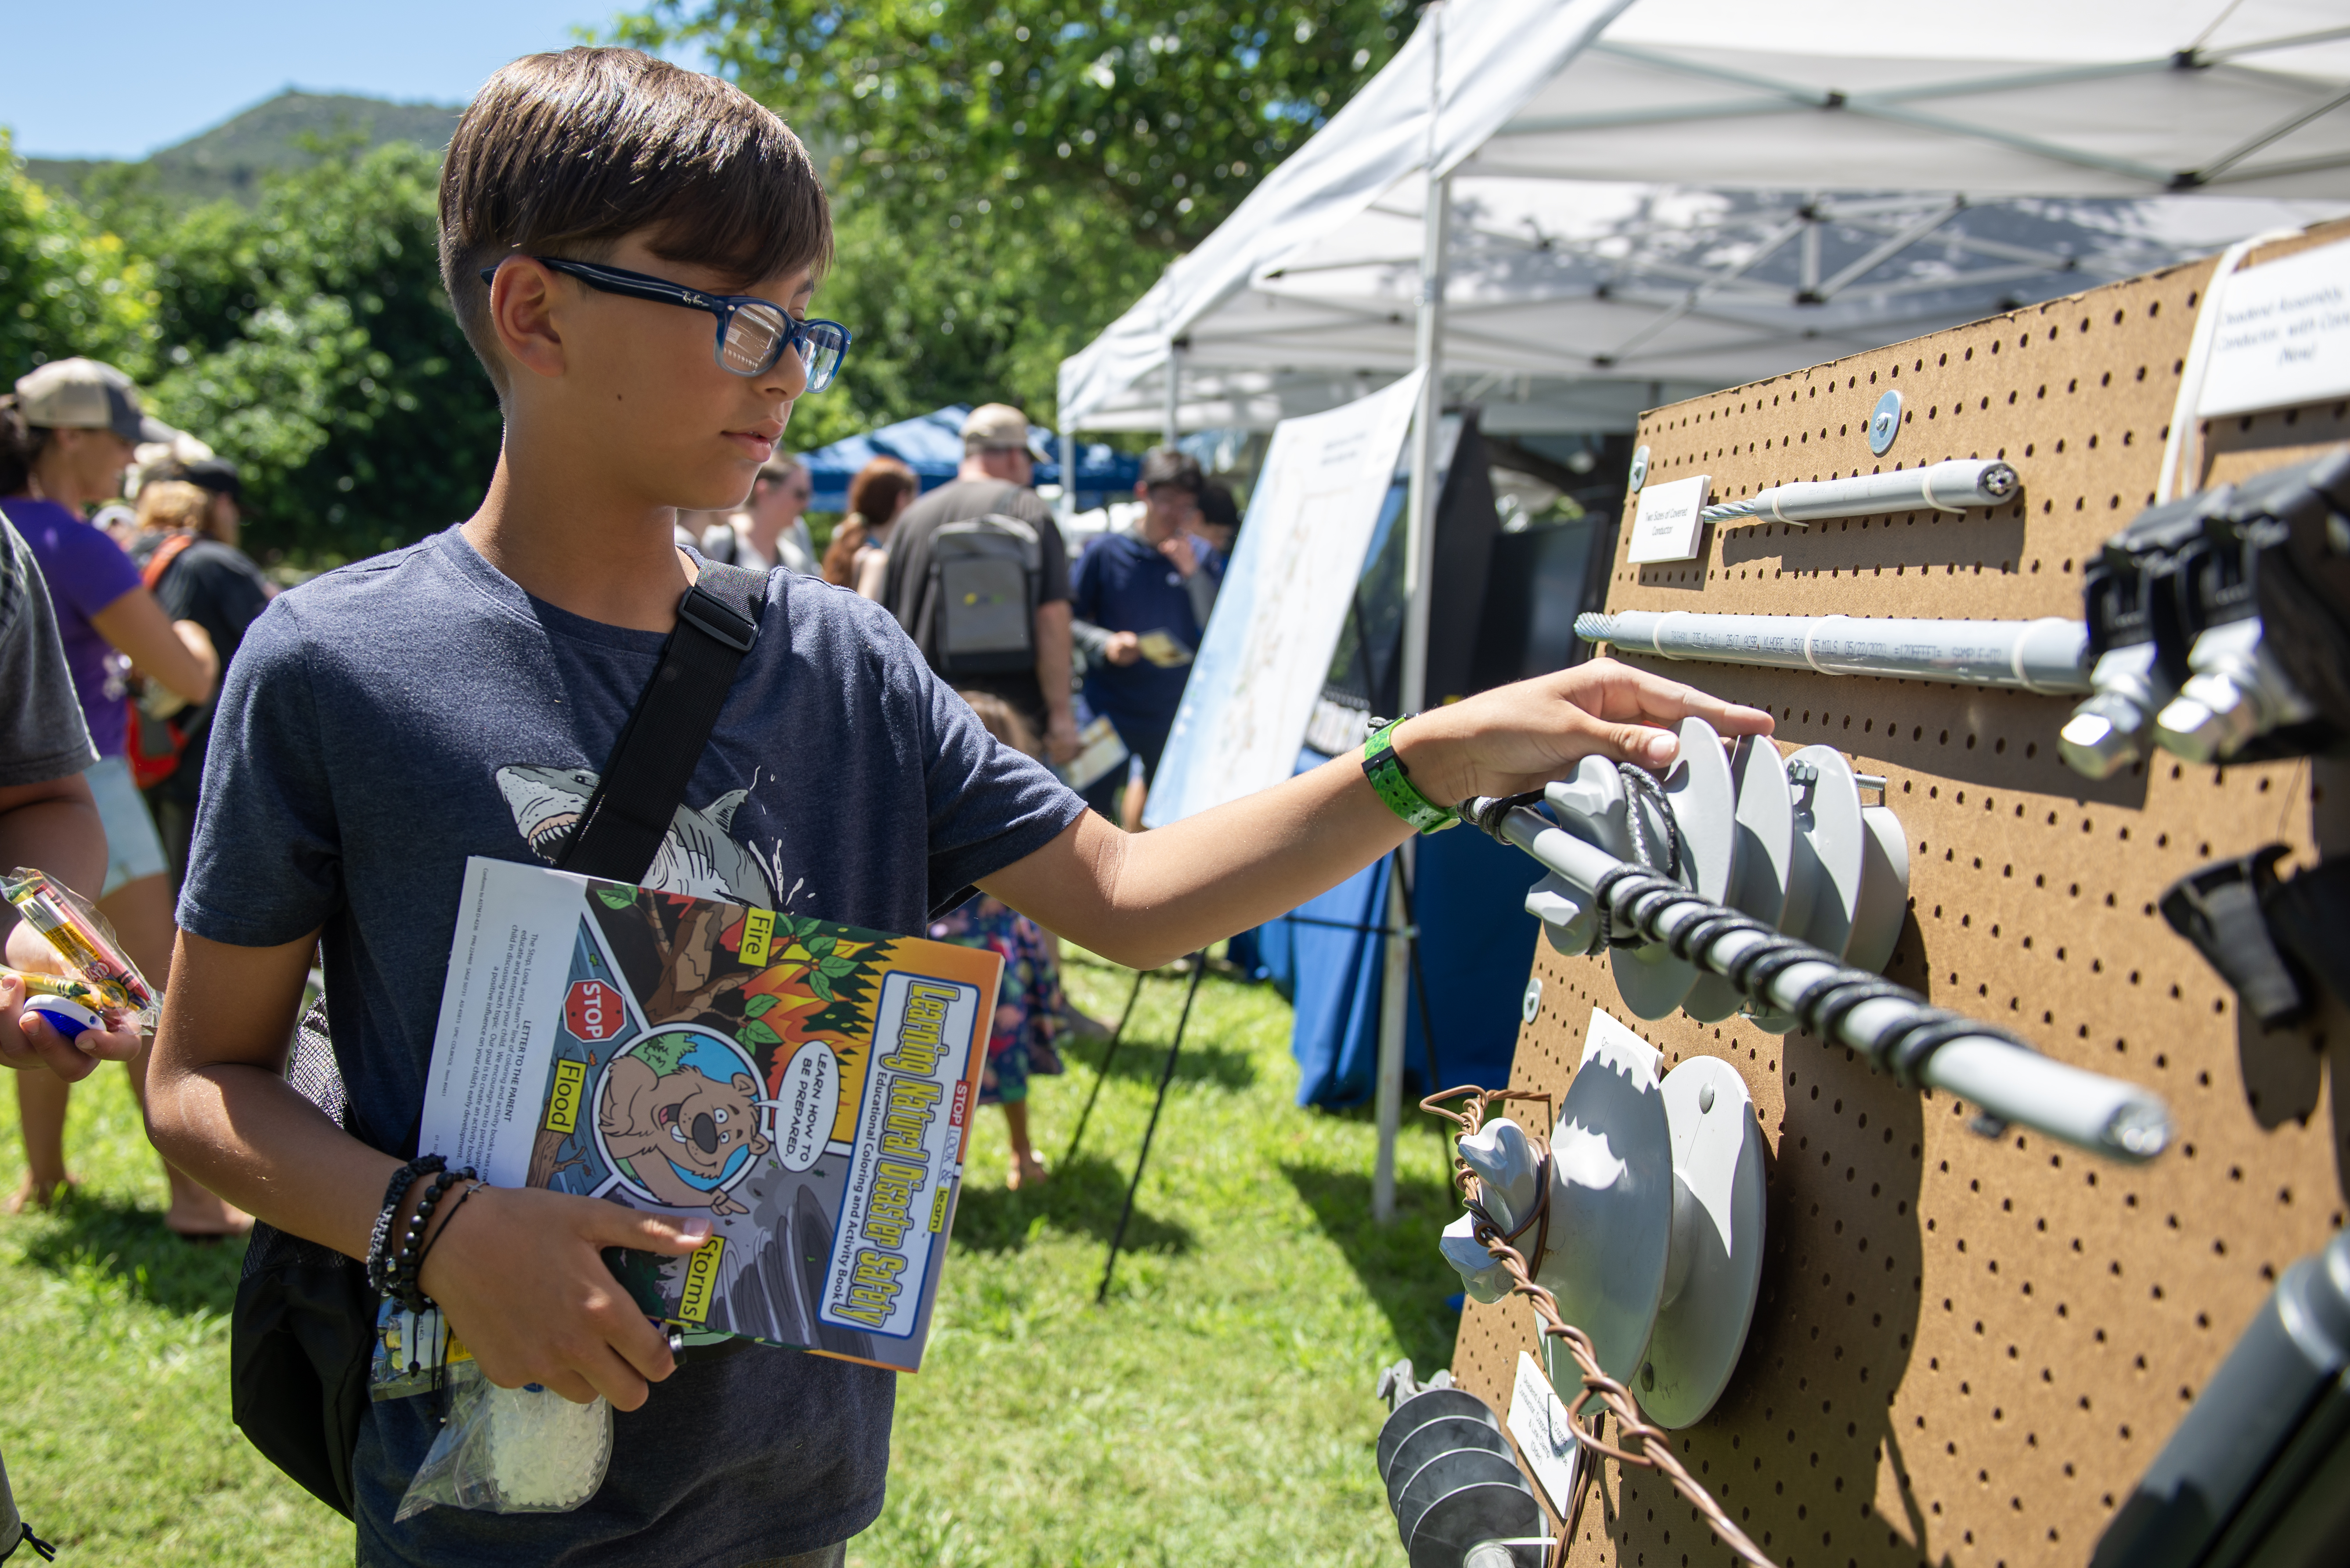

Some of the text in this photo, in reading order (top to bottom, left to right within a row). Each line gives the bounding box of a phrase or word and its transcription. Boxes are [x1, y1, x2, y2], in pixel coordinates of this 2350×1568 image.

[1670, 506, 1689, 518] Covered
[1652, 526, 1673, 536] Conductor
[1726, 633, 1740, 647] 26/7
[1821, 639, 1838, 655] MILS
[509, 924, 519, 942] child
[516, 930, 527, 959] educate
[529, 934, 538, 947] The
[746, 916, 770, 954] Fire
[498, 952, 513, 989] discussing
[524, 948, 535, 966] Stop,
[487, 972, 497, 1000] positive
[521, 968, 531, 985] Look
[496, 991, 504, 1008] each
[506, 976, 518, 1009] entertain
[480, 1002, 493, 1036] influence
[491, 1010, 501, 1029] topic.
[582, 983, 602, 1038] STOP
[478, 1037, 485, 1047] on
[488, 1033, 497, 1047] Our
[498, 1028, 508, 1047] child.
[508, 1044, 515, 1053] of
[509, 1029, 519, 1043] line
[484, 1048, 493, 1065] goal
[495, 1051, 504, 1063] We
[499, 1054, 512, 1084] coloring
[486, 1064, 499, 1103] encourage
[504, 1020, 531, 1122] LETTER TO THE PARENT
[464, 1090, 473, 1108] early
[476, 1082, 485, 1105] create
[551, 1065, 580, 1126] Flood
[786, 1058, 811, 1156] BE PREPARED.
[474, 1106, 480, 1116] an
[490, 1100, 502, 1128] activity
[800, 1053, 827, 1162] LEARN HOW TO
[456, 1109, 471, 1159] development.
[467, 1117, 478, 1144] activity
[487, 1129, 498, 1151] books
[465, 1145, 475, 1164] book
[471, 1129, 486, 1168] participate
[831, 981, 959, 1328] Learning Natural Disaster Safety
[931, 1083, 967, 1230] STOP LOOK & learn
[832, 1072, 887, 1299] Educational Coloring and Activity Book
[684, 1239, 718, 1316] Storms
[1523, 1373, 1538, 1402] Deadend
[1554, 1421, 1568, 1447] Copper
[1531, 1439, 1543, 1466] (Older)
[1536, 1411, 1549, 1437] Copper
[1548, 1430, 1568, 1467] Horseshoe
[1539, 1435, 1551, 1460] Clamp
